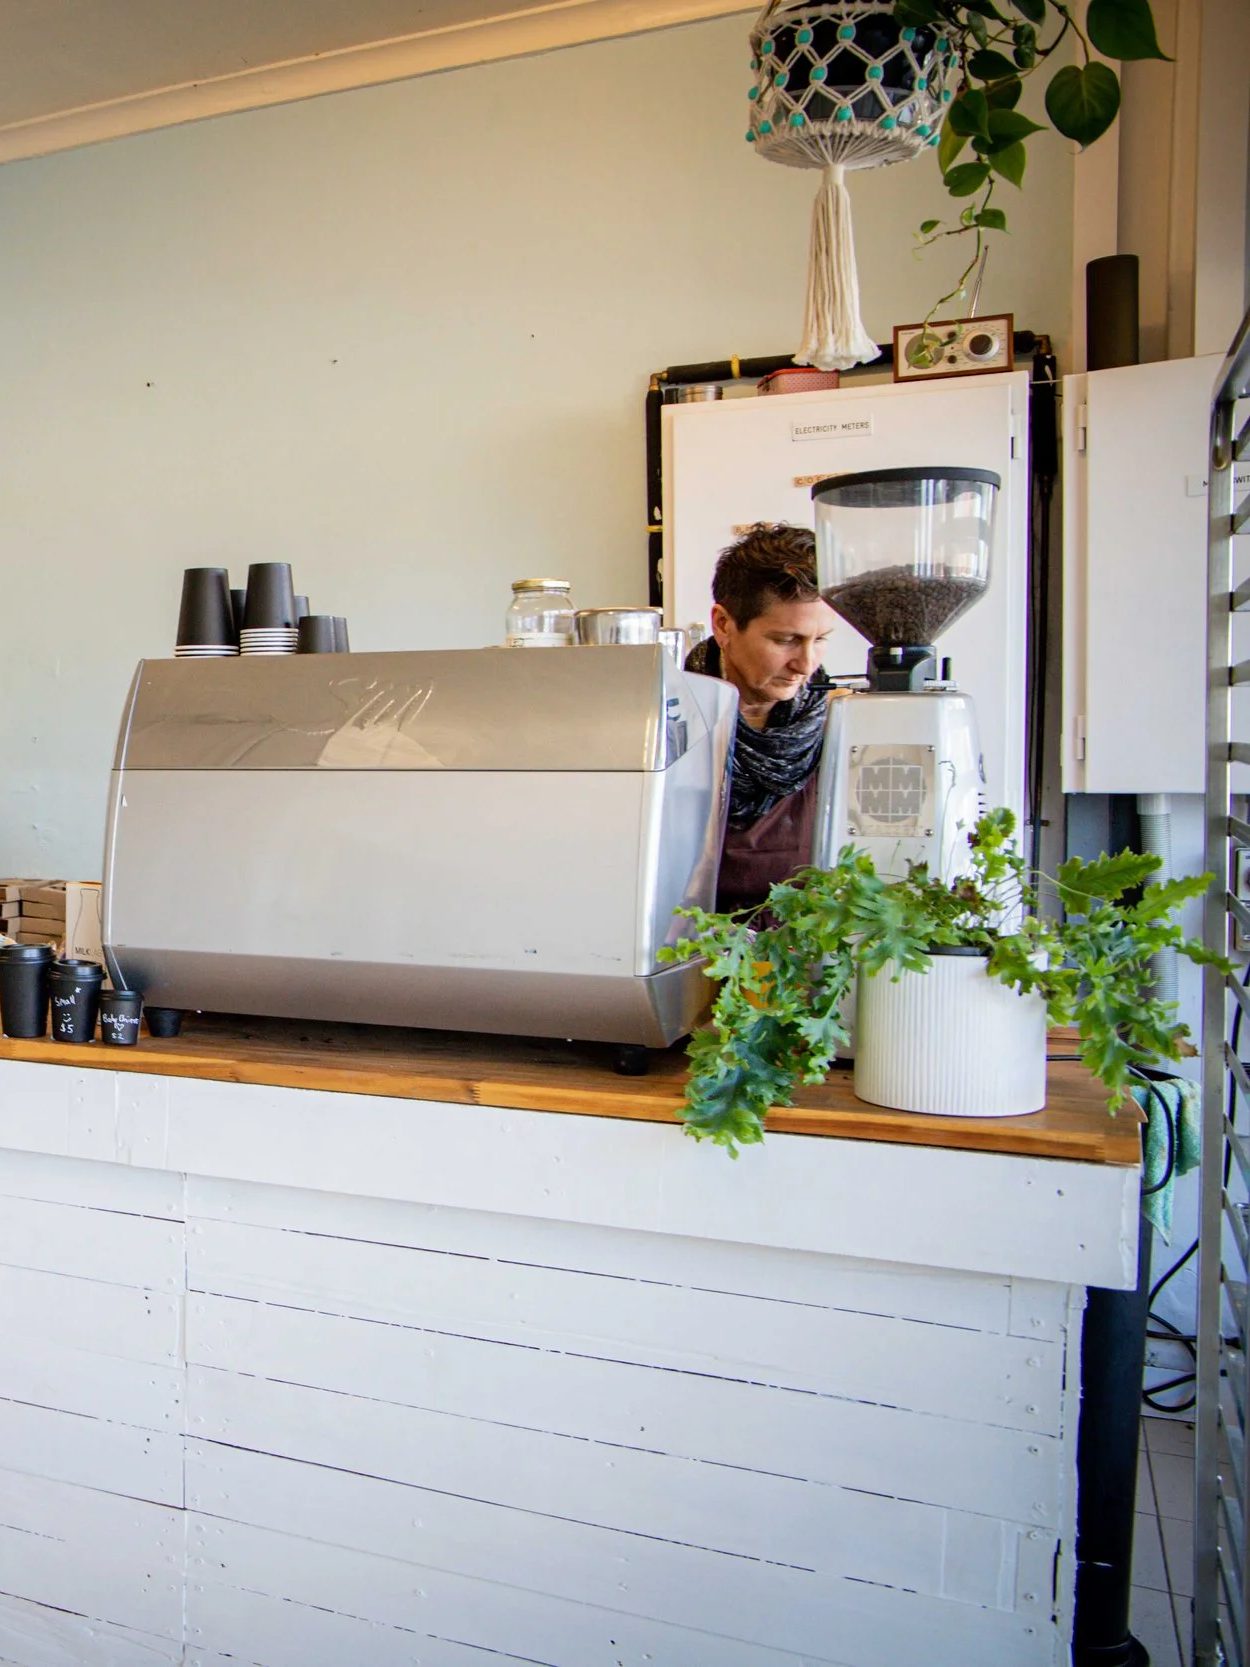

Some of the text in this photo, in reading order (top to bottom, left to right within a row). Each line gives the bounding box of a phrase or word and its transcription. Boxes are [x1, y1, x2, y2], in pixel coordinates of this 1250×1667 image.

[795, 421, 869, 434] ELECTRICITY METERS
[59, 1022, 74, 1034] $5
